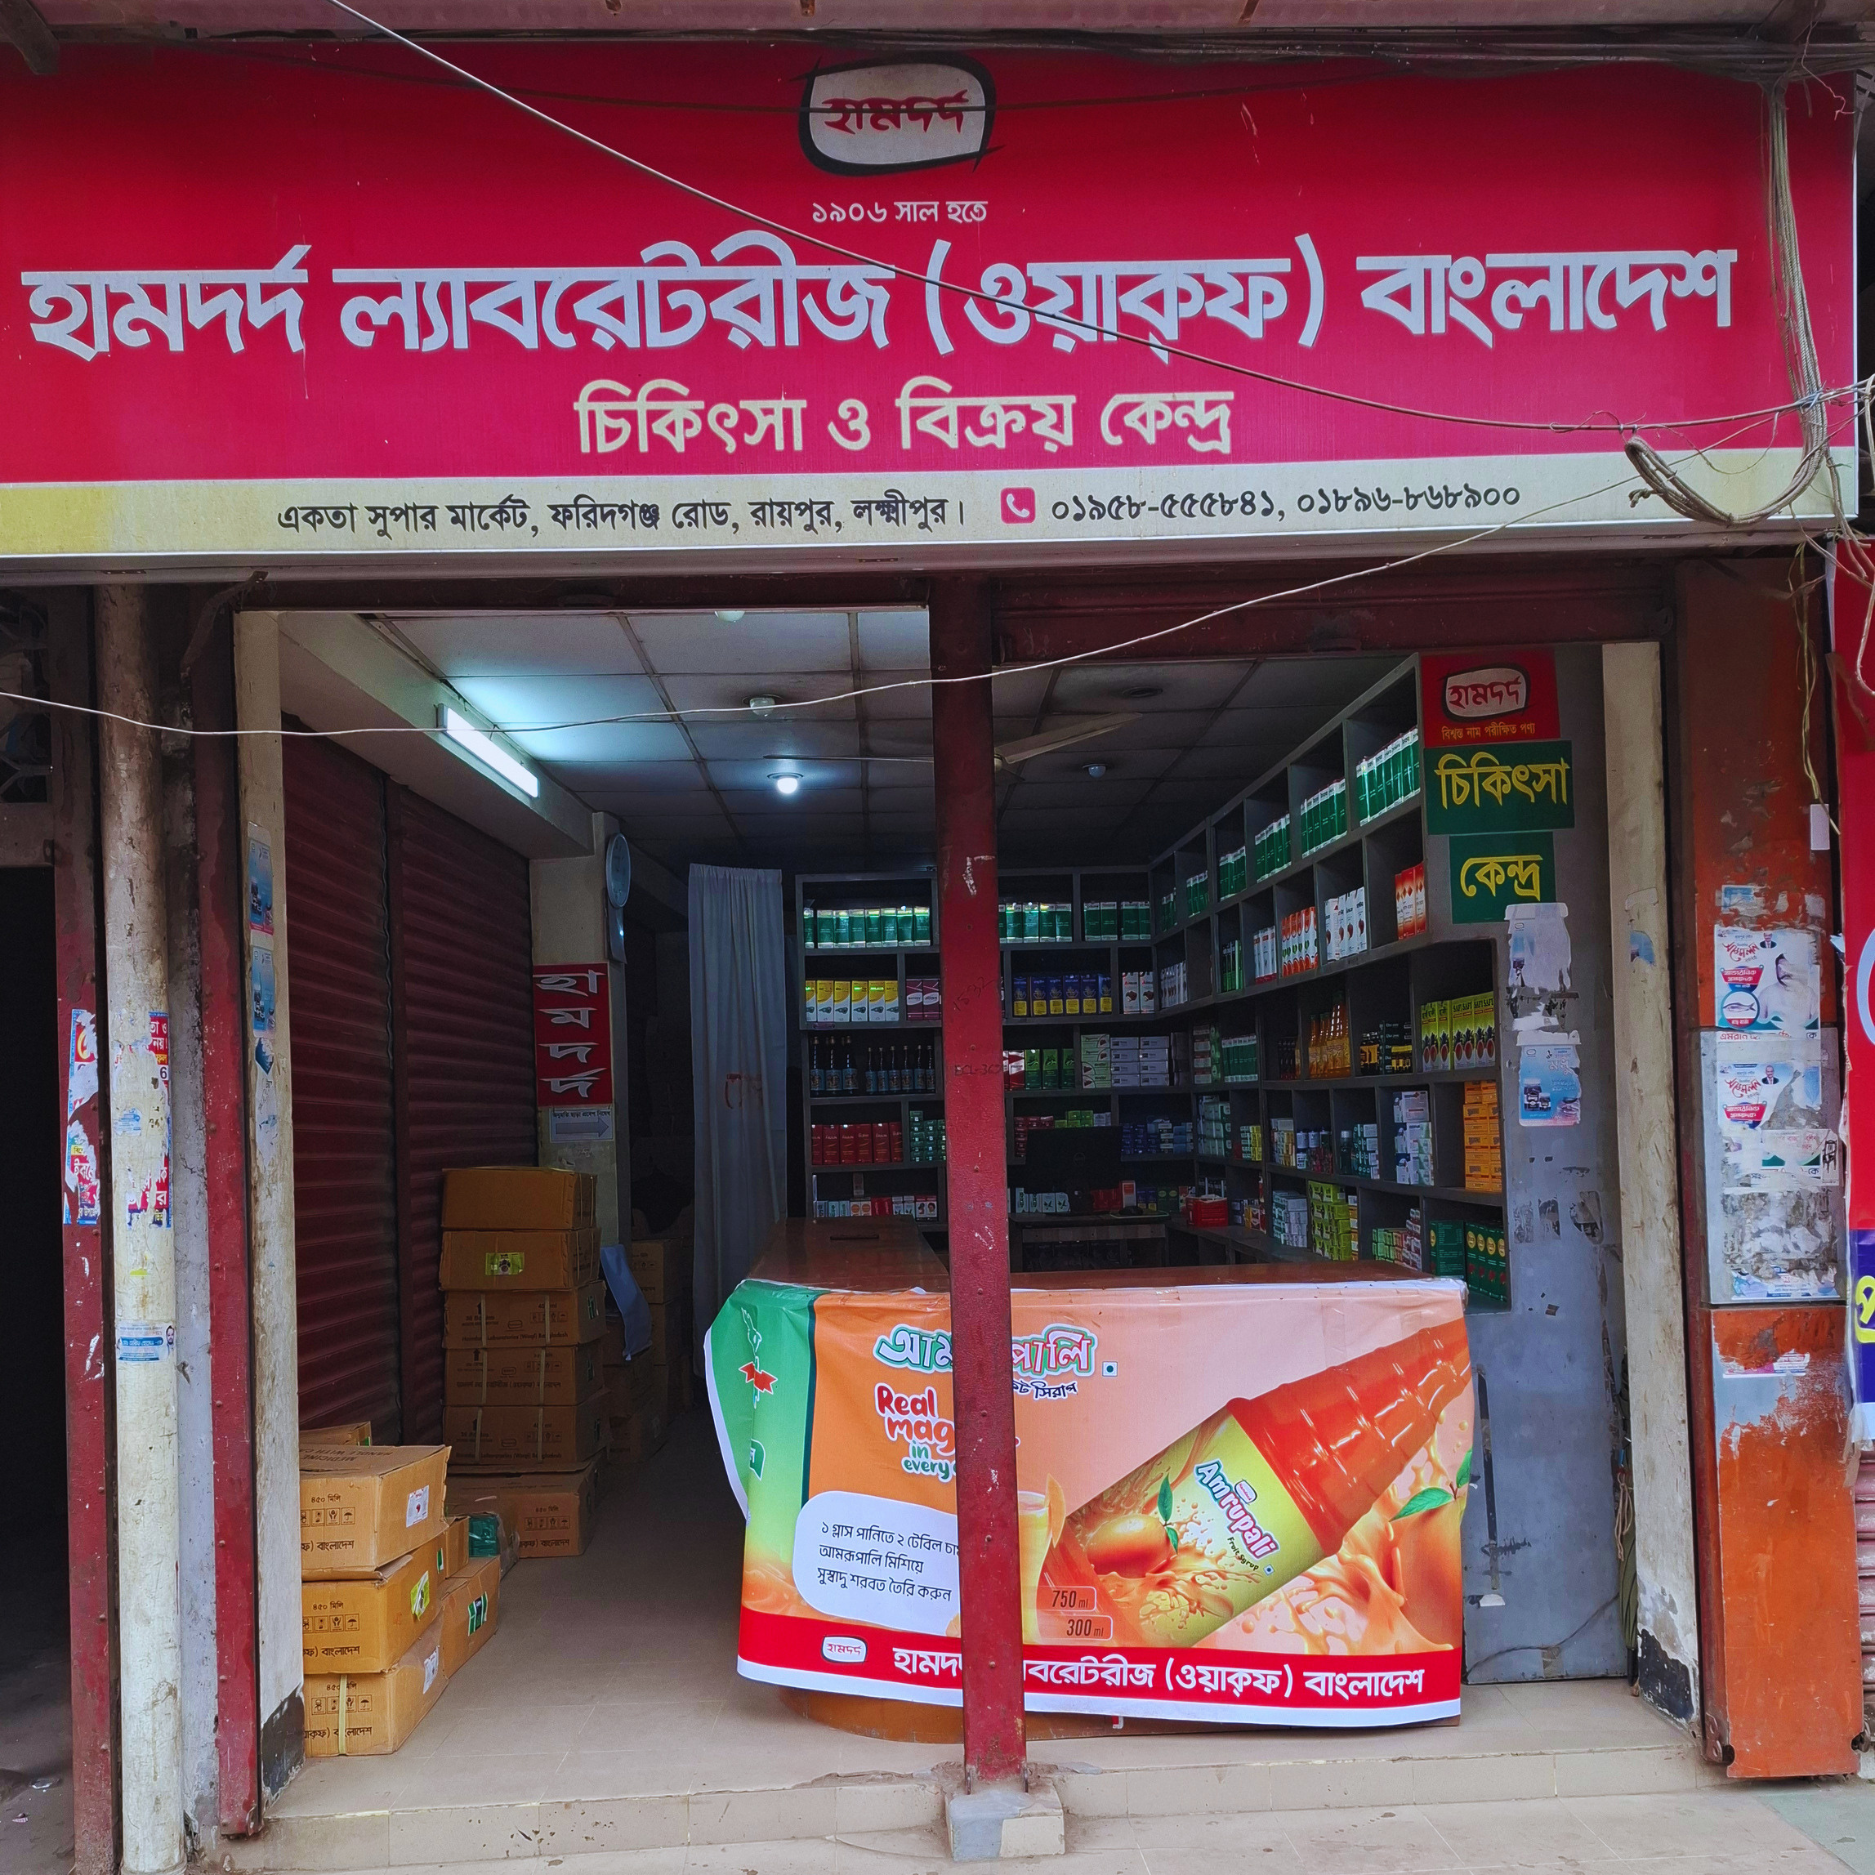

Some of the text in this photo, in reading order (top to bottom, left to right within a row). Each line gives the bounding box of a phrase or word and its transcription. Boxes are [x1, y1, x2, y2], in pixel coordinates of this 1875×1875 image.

[822, 88, 969, 135] হামদর্দ
[812, 201, 988, 223] ১৯০৬ সাল হতে
[21, 243, 310, 362] হামদর্দ
[332, 230, 896, 350] ল্যাবরেটরীজ
[1357, 247, 1737, 347] বাংলাদেশ
[574, 375, 1234, 455] চিকিৎসা ও বিক্রয় কেন্দ্র
[278, 502, 358, 533] একতা
[364, 502, 439, 540] সুপার
[446, 494, 538, 538] মার্কেট,
[547, 494, 660, 532] ফরিদগঞ্জ
[672, 499, 740, 534] রোড,
[748, 498, 843, 534] রায়পুর,
[1052, 490, 1285, 522] ০১৯৫৮-৫৫৫৮৪১,
[1298, 483, 1520, 515] ০১৮৯৬-৮৬৮৯০০
[1447, 676, 1521, 709] হামদর্দ
[1434, 752, 1570, 809] চিকিৎসা
[1460, 855, 1543, 901] কেন্দ্র
[876, 1384, 936, 1417] Real
[1031, 1380, 1078, 1398] সিরাপ
[886, 1416, 956, 1453] mag
[911, 1440, 929, 1458] in
[903, 1459, 952, 1480] every
[1196, 1460, 1279, 1559] Amrupali
[316, 1540, 354, 1552] বাংলাদেশ
[821, 1521, 829, 1534] ১
[832, 1523, 854, 1539] গ্লাস
[856, 1525, 896, 1544] পানিতে
[897, 1534, 905, 1546] ২
[907, 1533, 942, 1552] টেবিল
[1227, 1536, 1240, 1555] Fruit
[819, 1544, 924, 1574] আমরূপালি মিশিয়ে
[817, 1567, 952, 1601] সুস্বাদু শরবত তৈরি করুন
[1052, 1590, 1088, 1608] 750 ml
[1067, 1619, 1104, 1637] 300 ml
[321, 1646, 360, 1658] বাংলাদেশ
[892, 1647, 963, 1677] হামদ
[1023, 1653, 1156, 1688] বরেটরীজ
[1303, 1668, 1425, 1700] বাংলাদেশ
